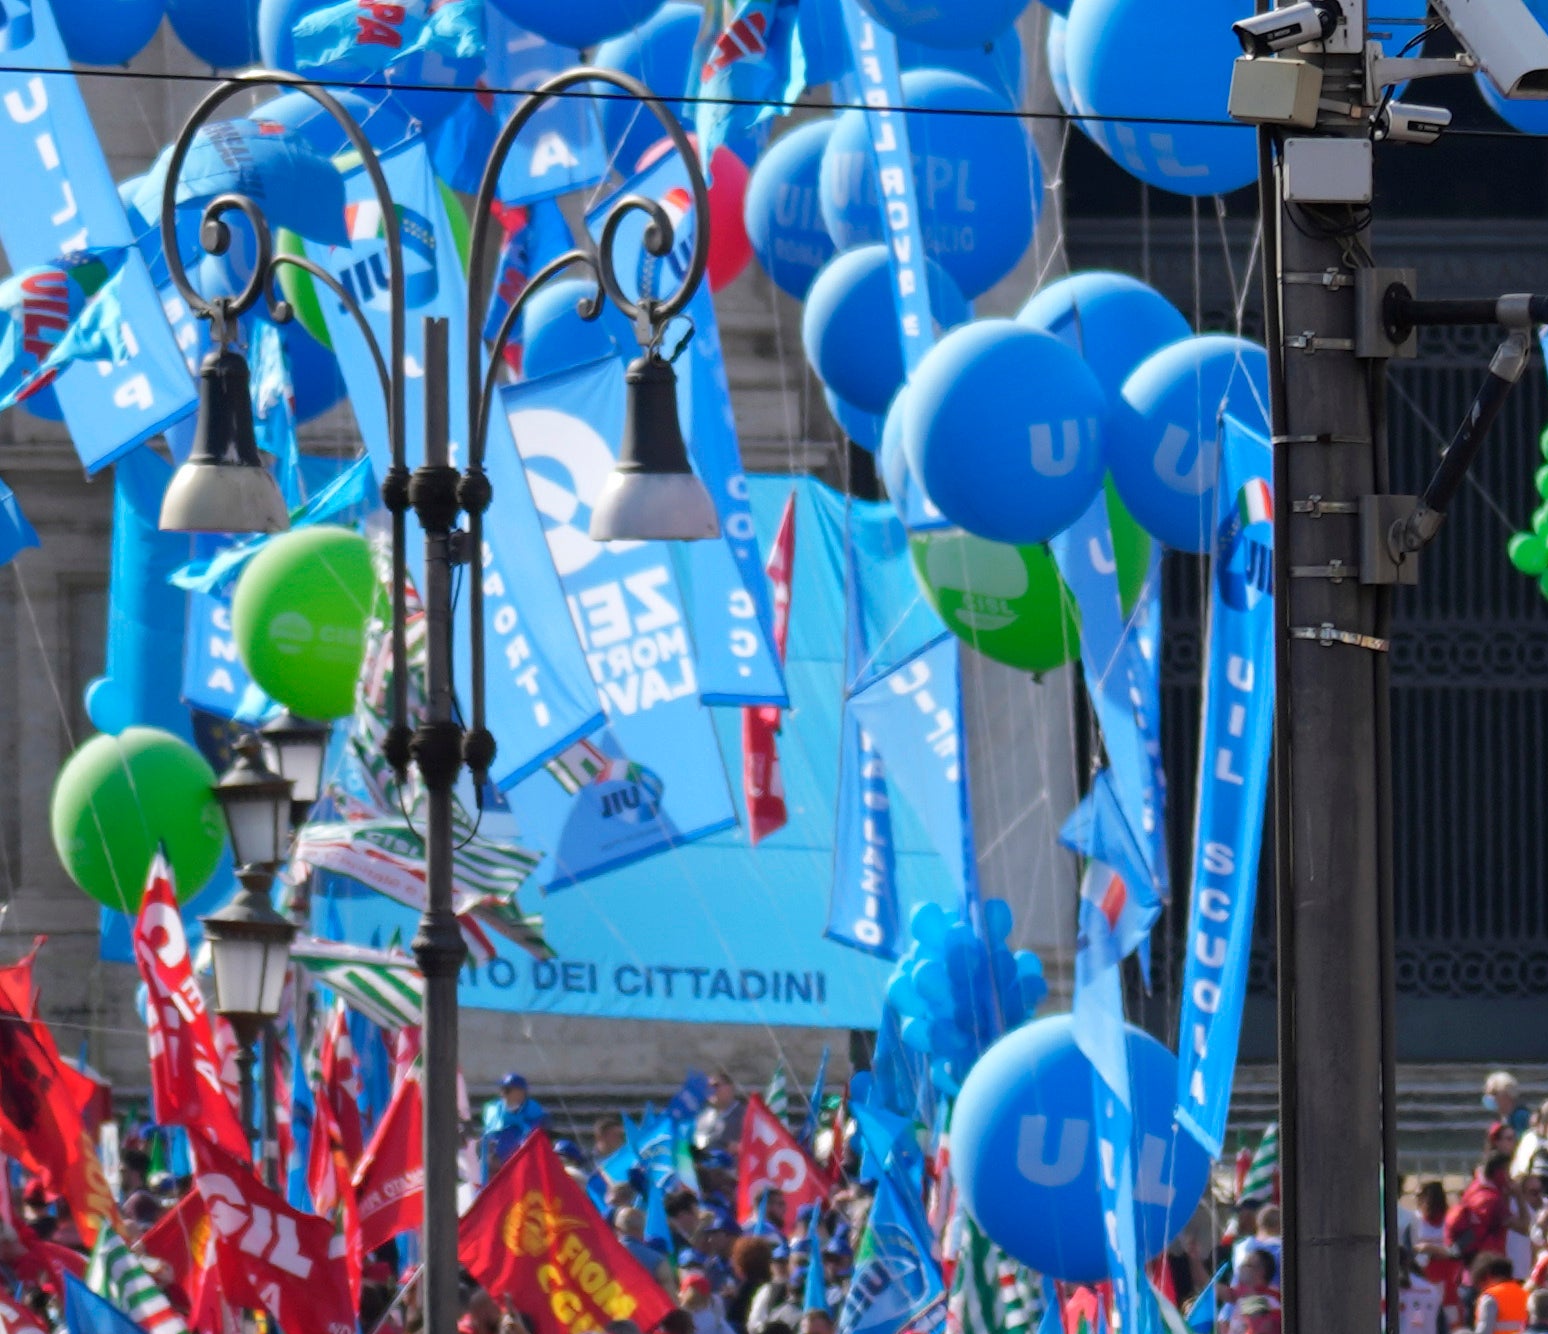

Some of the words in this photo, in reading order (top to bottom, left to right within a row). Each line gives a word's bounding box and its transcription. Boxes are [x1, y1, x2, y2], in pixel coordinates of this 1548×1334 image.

[1227, 656, 1255, 789] UIL
[534, 961, 597, 997] DEI
[613, 963, 826, 1004] CITTADINI
[1016, 1114, 1177, 1208] UL
